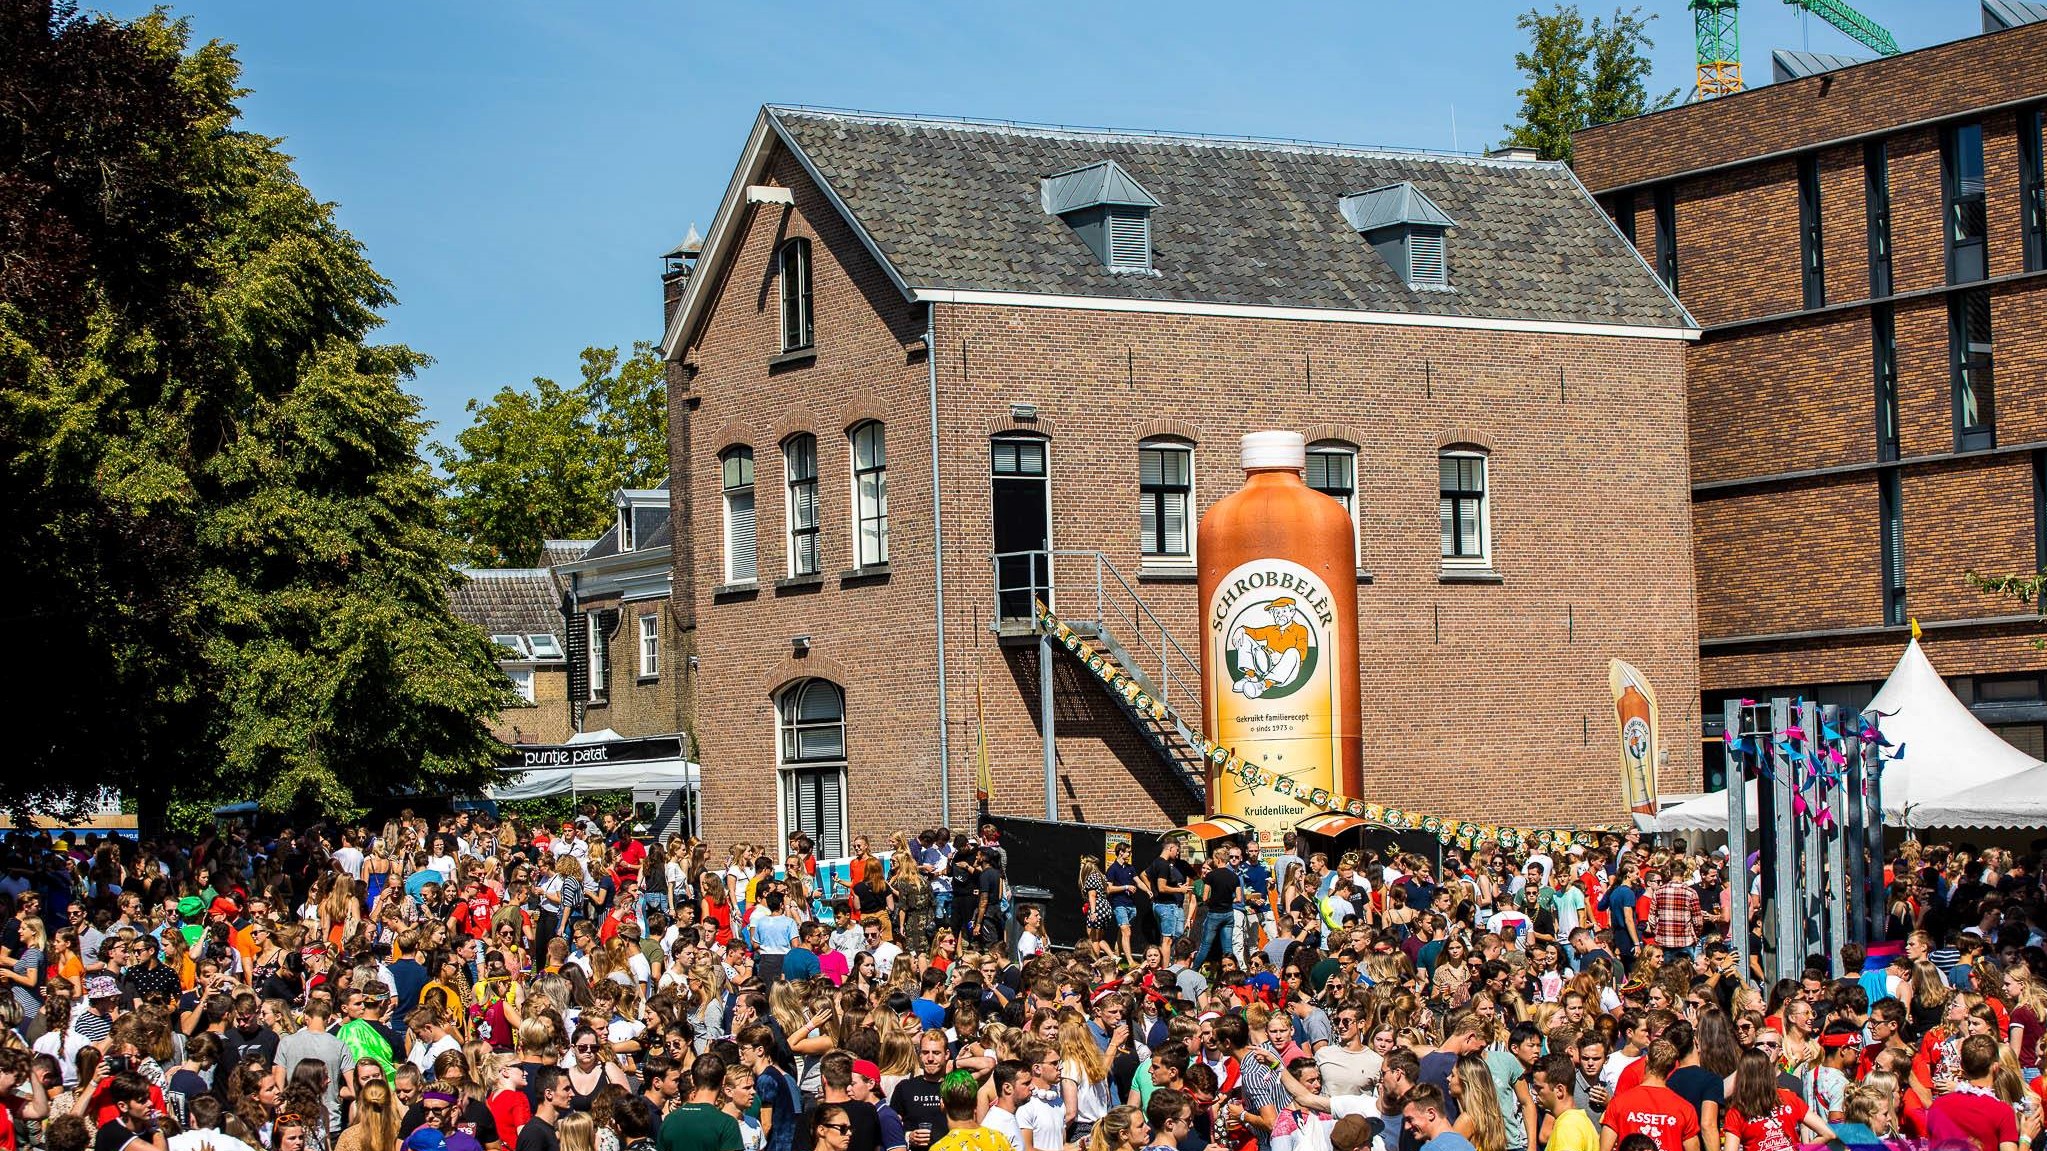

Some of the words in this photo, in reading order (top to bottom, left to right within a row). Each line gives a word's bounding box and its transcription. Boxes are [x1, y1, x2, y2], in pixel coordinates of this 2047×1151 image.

[1212, 571, 1333, 632] SCHROBBELÈR
[1235, 714, 1264, 723] Gekruikt
[1265, 713, 1309, 722] familierecept
[1272, 724, 1288, 732] 1973
[524, 748, 570, 767] puntje
[572, 745, 608, 765] patat
[1244, 805, 1305, 816] Kruidenlikeur
